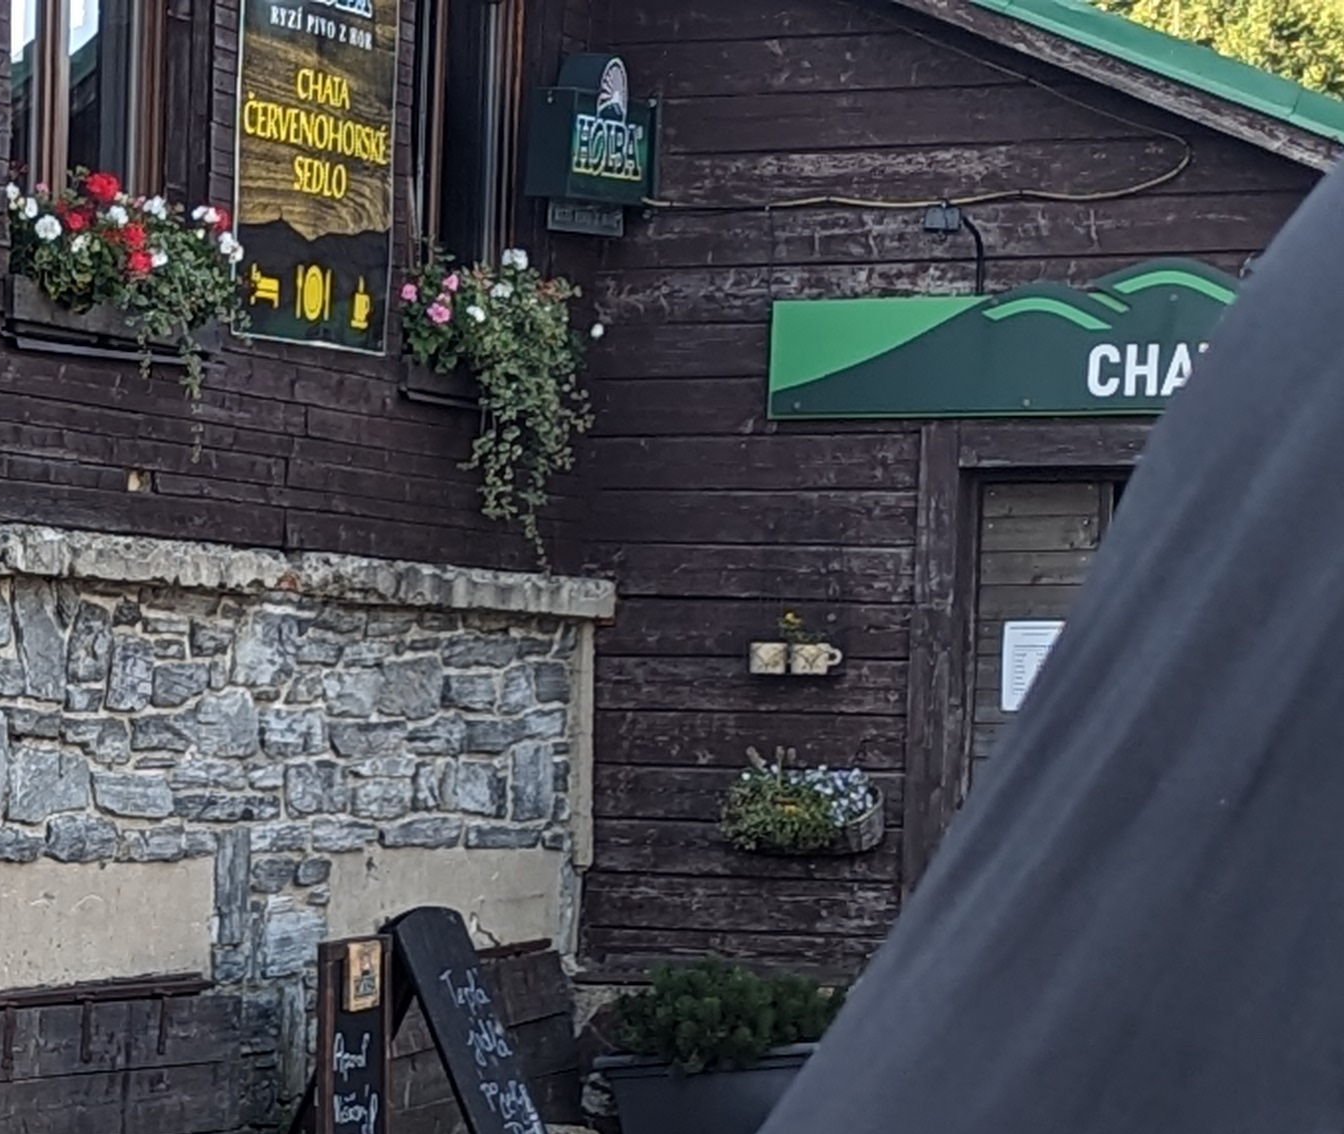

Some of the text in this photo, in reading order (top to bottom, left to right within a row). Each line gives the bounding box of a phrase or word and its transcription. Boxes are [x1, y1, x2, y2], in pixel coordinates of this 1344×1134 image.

[270, 5, 303, 30] RYZÍ
[306, 14, 336, 39] PIVO
[339, 24, 347, 42] Z
[349, 27, 373, 51] HOR
[296, 68, 350, 110] CHATA
[243, 92, 388, 165] ČERVENOHORSKÉ
[293, 156, 347, 200] SEDLO
[1087, 342, 1211, 398] CHA
